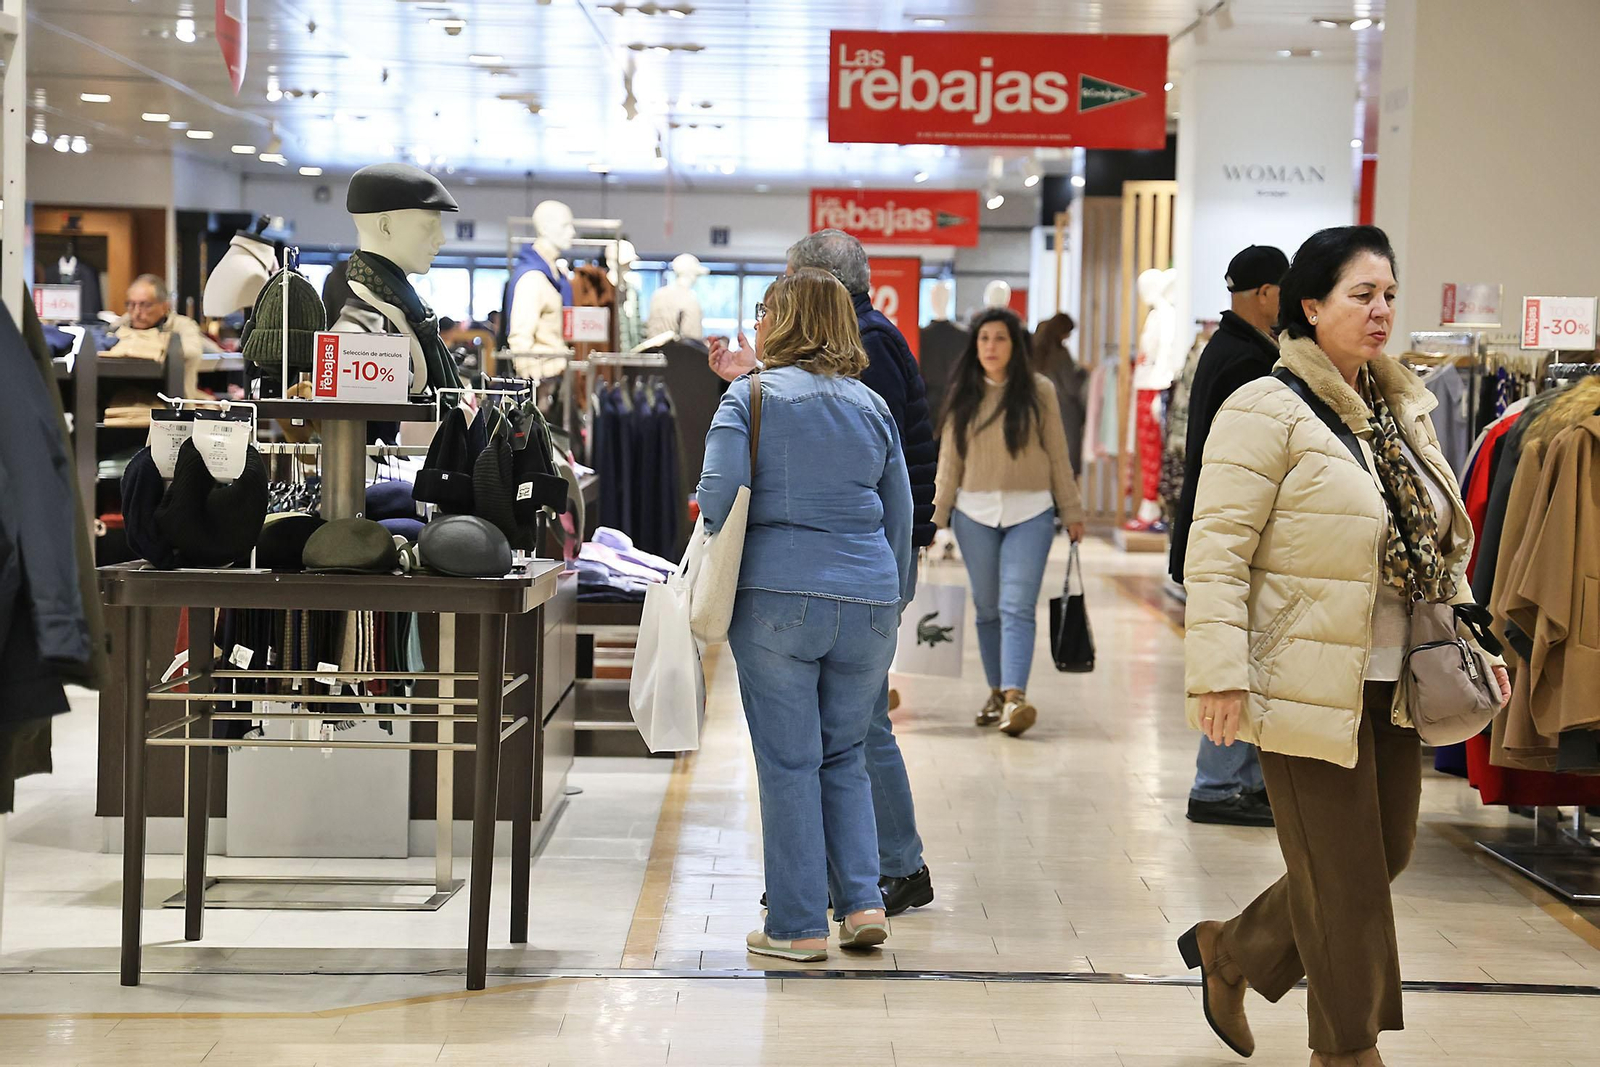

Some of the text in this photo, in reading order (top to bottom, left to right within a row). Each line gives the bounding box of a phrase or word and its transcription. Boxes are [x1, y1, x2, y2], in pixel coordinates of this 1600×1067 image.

[838, 43, 886, 67] Las
[838, 55, 1069, 125] rebajas
[1222, 163, 1326, 184] WOMAN
[816, 200, 933, 237] rebajas
[1549, 306, 1586, 318] TODO
[1543, 319, 1590, 335] -30%
[321, 344, 336, 390] rebajas
[342, 360, 395, 382] -10%
